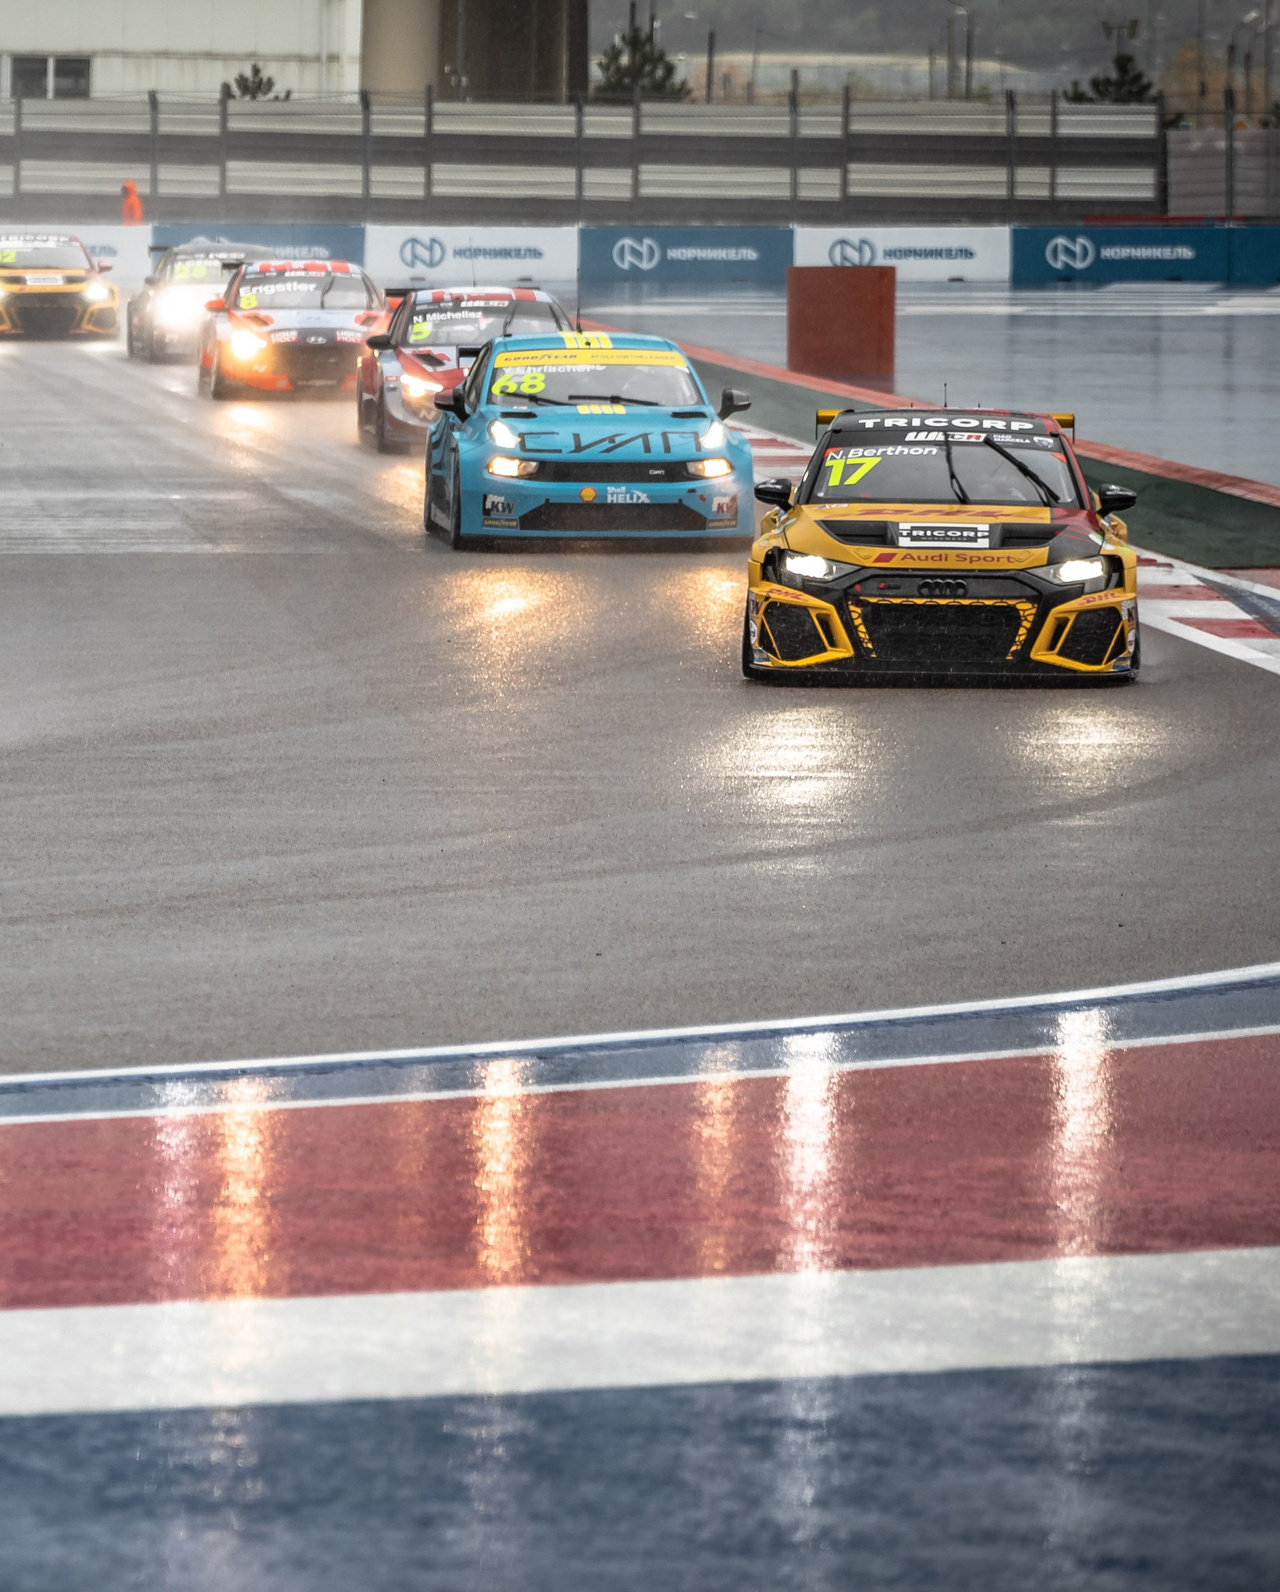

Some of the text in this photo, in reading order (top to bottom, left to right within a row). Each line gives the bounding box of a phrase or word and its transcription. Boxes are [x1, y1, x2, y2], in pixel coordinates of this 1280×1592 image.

[452, 248, 544, 260] НОРНИКЕЛЬ
[666, 247, 759, 261] НОРНИКЕЛЬ
[883, 248, 976, 261] НОРНИКЕЛЬ
[1099, 245, 1195, 260] НОРНИКЕЛЬ
[239, 281, 318, 297] Engstler
[239, 294, 258, 310] 8
[410, 321, 433, 341] 5
[490, 372, 546, 396] 68
[858, 417, 1035, 431] TRICORP
[825, 457, 882, 487] 17
[606, 490, 651, 504] HELIX
[899, 529, 990, 538] TRICORP
[900, 552, 1015, 565] Audi Sport
